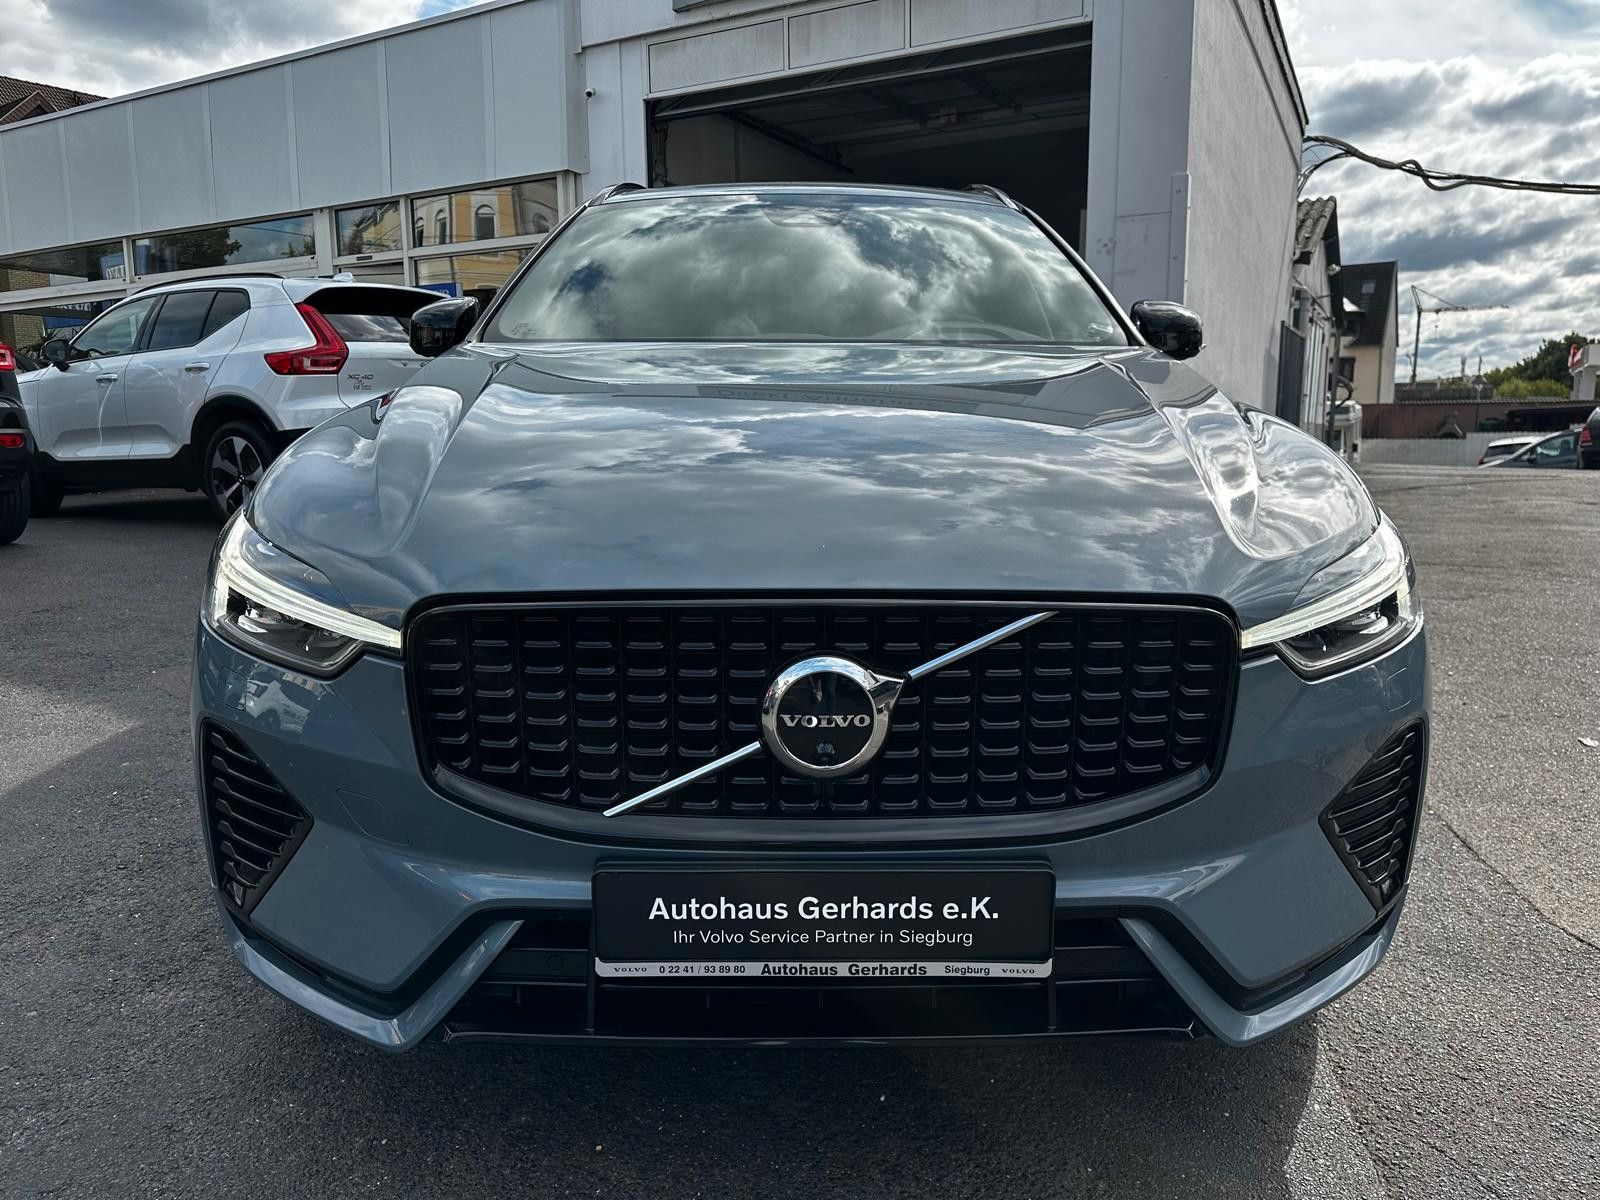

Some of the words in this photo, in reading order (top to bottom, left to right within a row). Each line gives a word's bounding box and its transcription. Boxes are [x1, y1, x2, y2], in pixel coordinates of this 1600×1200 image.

[780, 713, 871, 728] VOLVO
[648, 896, 789, 920] Autohaus
[797, 896, 934, 920] Gerhards
[942, 896, 999, 920] e.K.
[673, 929, 695, 944] Ihr
[699, 929, 744, 944] Volvo
[749, 929, 810, 944] Service
[815, 929, 875, 944] Partner
[880, 929, 894, 944] in
[899, 929, 973, 946] Siegburg
[659, 965, 665, 974] 0
[668, 965, 680, 974] 22
[683, 965, 694, 974] 41
[704, 965, 716, 974] 93
[719, 965, 731, 974] 89
[733, 965, 746, 974] 80
[761, 963, 838, 976] Autohaus
[847, 963, 928, 976] Gerhards
[944, 965, 990, 976] Siegburg
